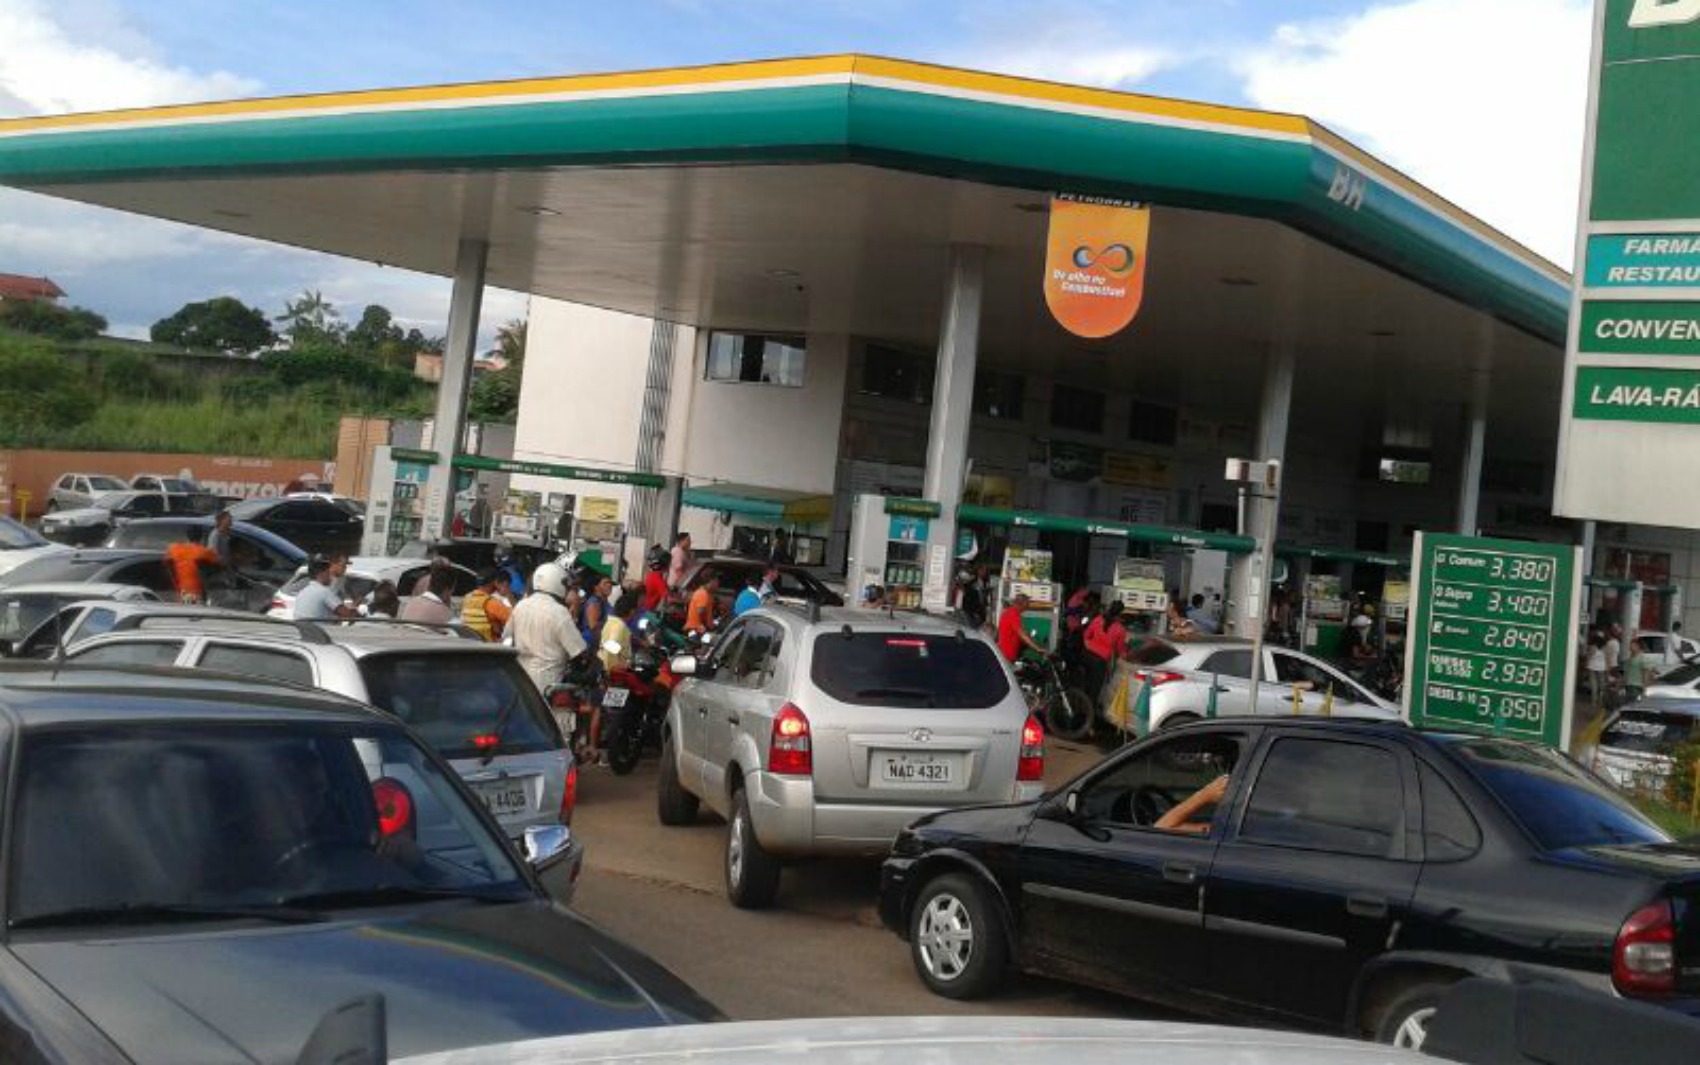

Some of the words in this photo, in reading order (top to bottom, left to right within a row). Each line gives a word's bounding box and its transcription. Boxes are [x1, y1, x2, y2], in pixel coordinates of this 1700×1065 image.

[1623, 239, 1700, 255] FARMA
[1607, 267, 1700, 283] RESTAU
[1596, 319, 1700, 340] CONVEN
[1490, 557, 1550, 582] 3.380
[1487, 591, 1547, 616] 3.400
[1484, 626, 1545, 651] 2.840
[1481, 661, 1543, 686] 2.930
[1478, 695, 1540, 720] 3.050
[918, 765, 949, 779] 4321
